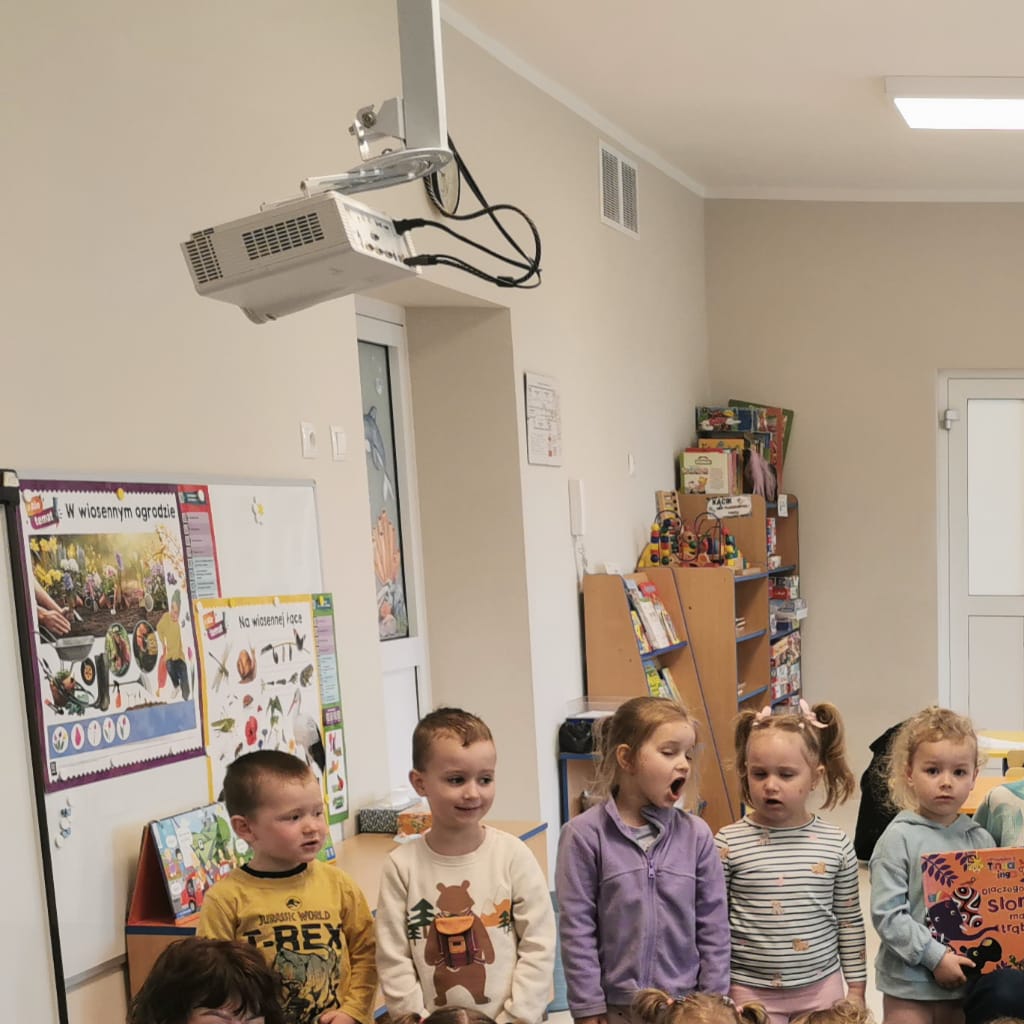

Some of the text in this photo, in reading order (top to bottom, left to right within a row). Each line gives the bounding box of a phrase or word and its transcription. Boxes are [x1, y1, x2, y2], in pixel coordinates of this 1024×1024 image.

[65, 503, 75, 519] W
[78, 503, 133, 522] wiosennym
[135, 502, 176, 522] ogrodzie
[238, 615, 250, 629] Na
[252, 612, 285, 628] wiosennej
[258, 910, 331, 925] JURASSIC WORLD
[243, 923, 344, 953] T-REX
